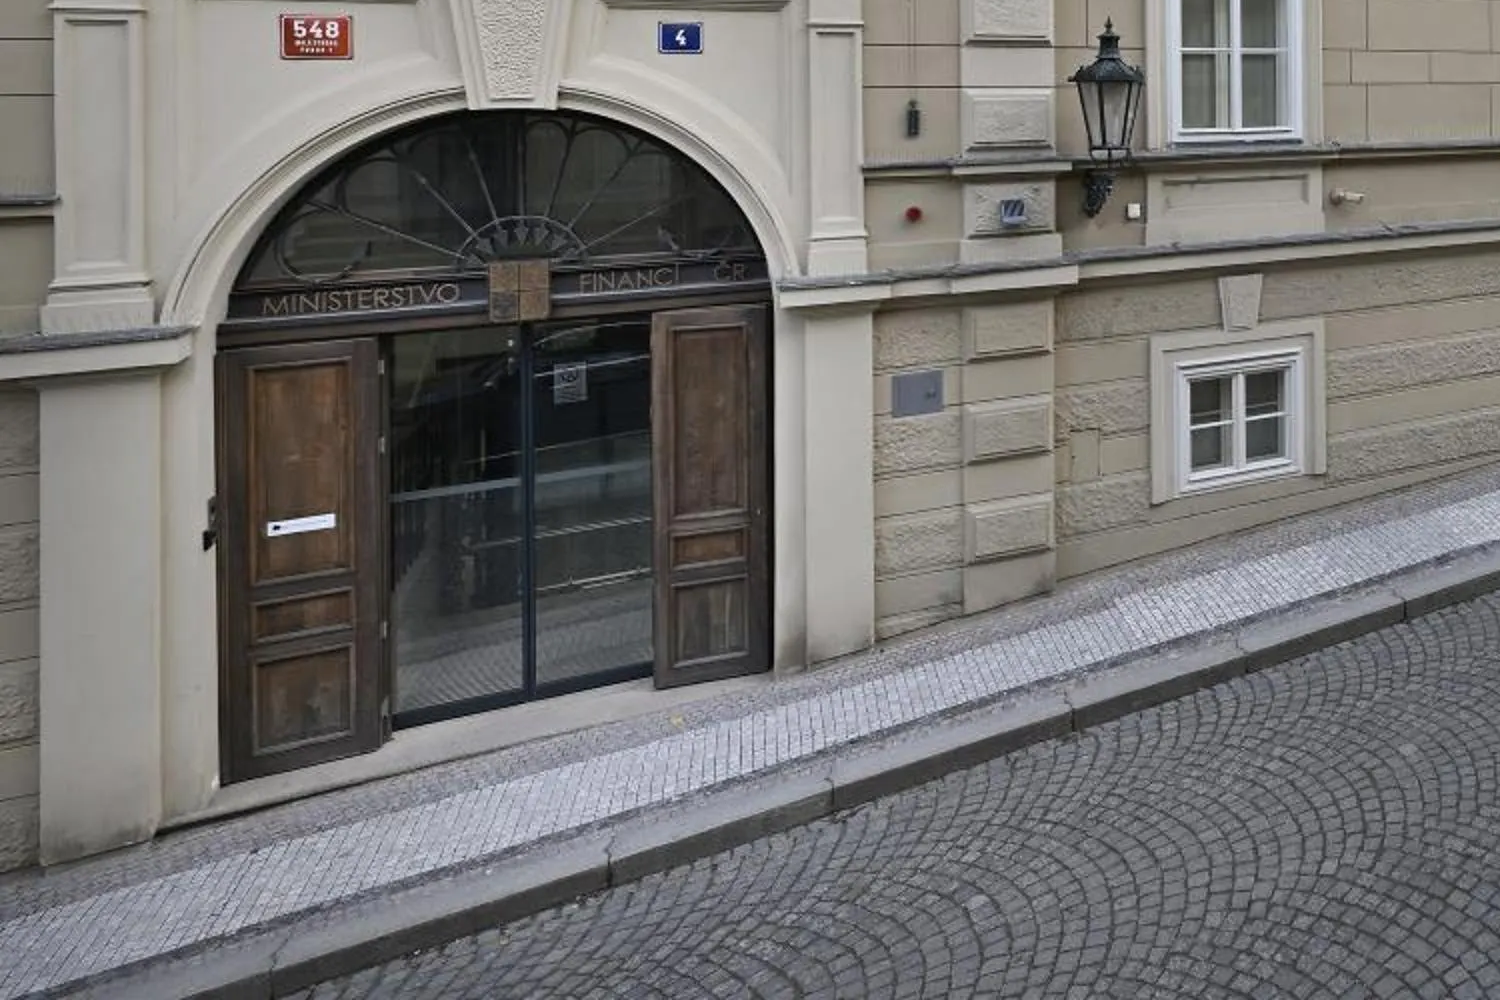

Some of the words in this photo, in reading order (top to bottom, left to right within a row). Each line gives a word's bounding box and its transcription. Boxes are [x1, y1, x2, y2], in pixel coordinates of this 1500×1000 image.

[293, 19, 340, 38] 548
[675, 29, 687, 46] 4
[264, 284, 461, 315] MINISTERSTVO
